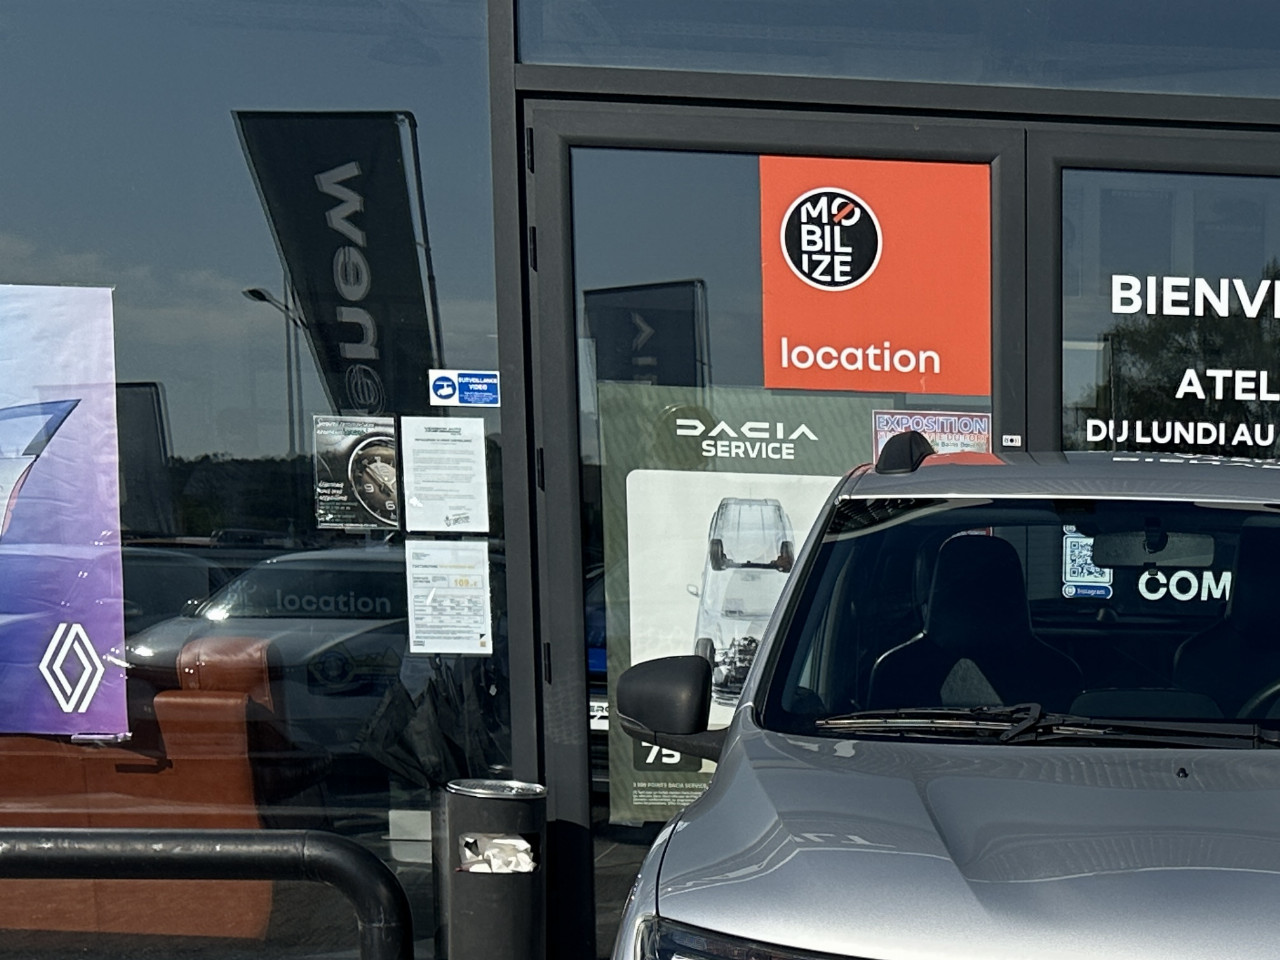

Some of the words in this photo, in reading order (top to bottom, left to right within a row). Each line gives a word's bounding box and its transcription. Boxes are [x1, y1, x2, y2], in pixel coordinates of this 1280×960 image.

[801, 224, 853, 253] BIL
[801, 253, 853, 283] IZE
[781, 336, 940, 375] location
[676, 418, 819, 441] DACIA
[875, 414, 988, 434] EXPOSITION
[1086, 418, 1132, 443] DU
[1134, 419, 1225, 445] LUNDI
[1232, 422, 1275, 447] AU
[701, 440, 795, 460] SERVICE
[276, 589, 392, 613] location
